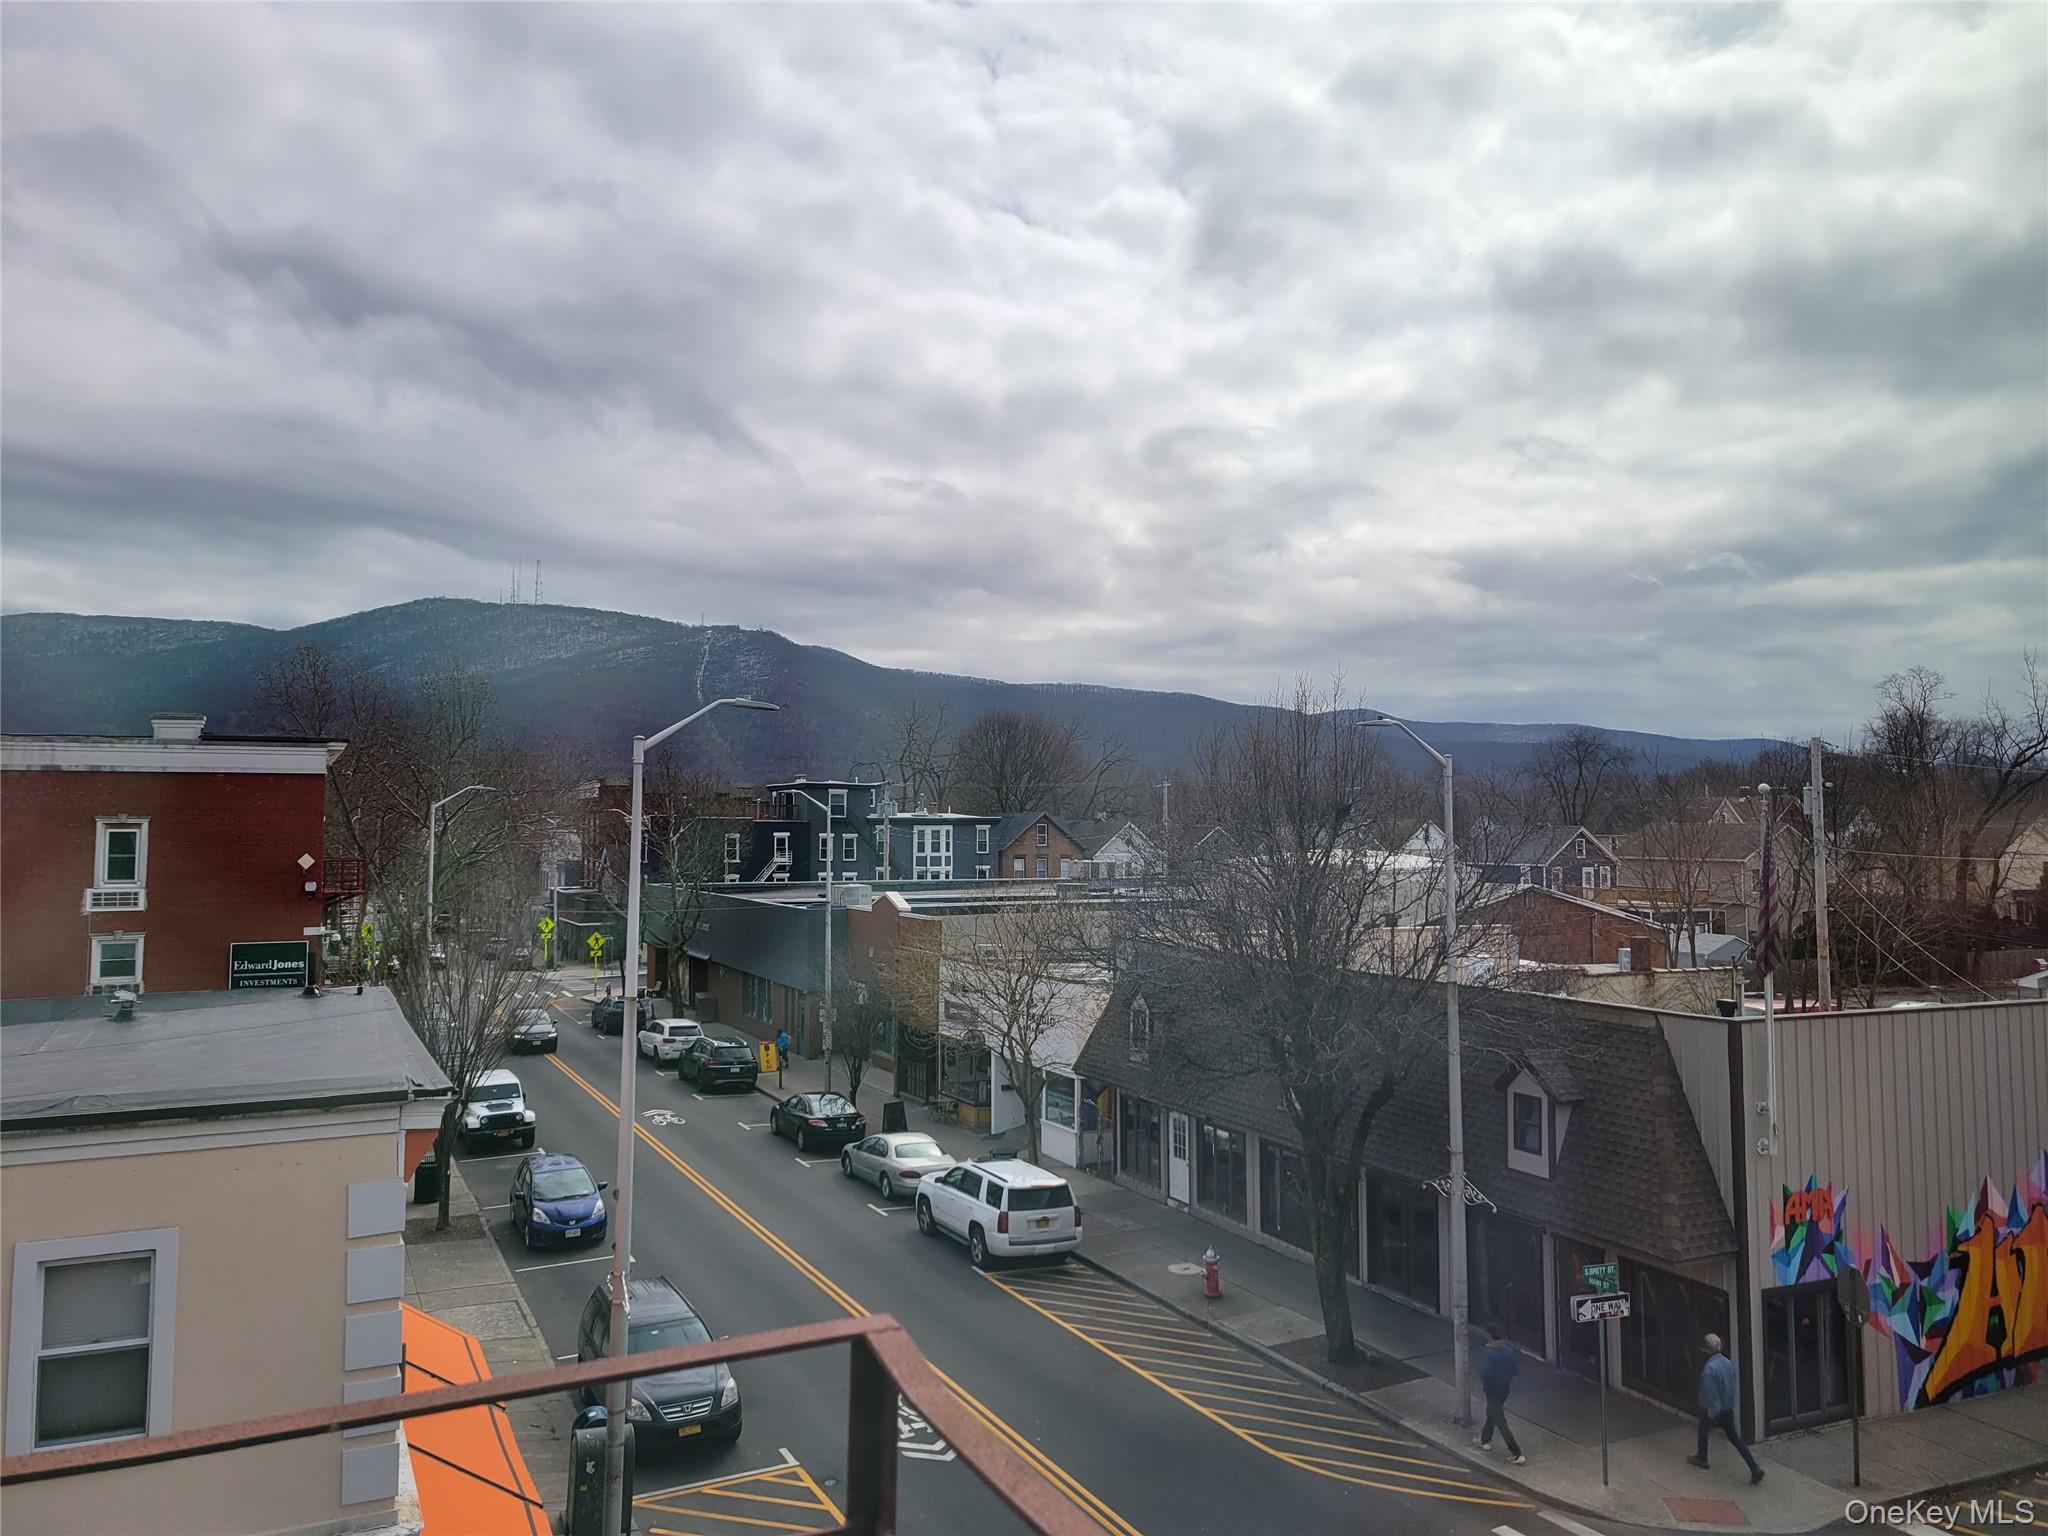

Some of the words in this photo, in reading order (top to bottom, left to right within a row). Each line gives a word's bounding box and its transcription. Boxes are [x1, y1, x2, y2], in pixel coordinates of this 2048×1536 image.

[233, 959, 272, 971] Edward
[272, 959, 305, 971] Jones
[239, 979, 298, 987] INVESTMENTS
[1590, 1302, 1606, 1313] ONE
